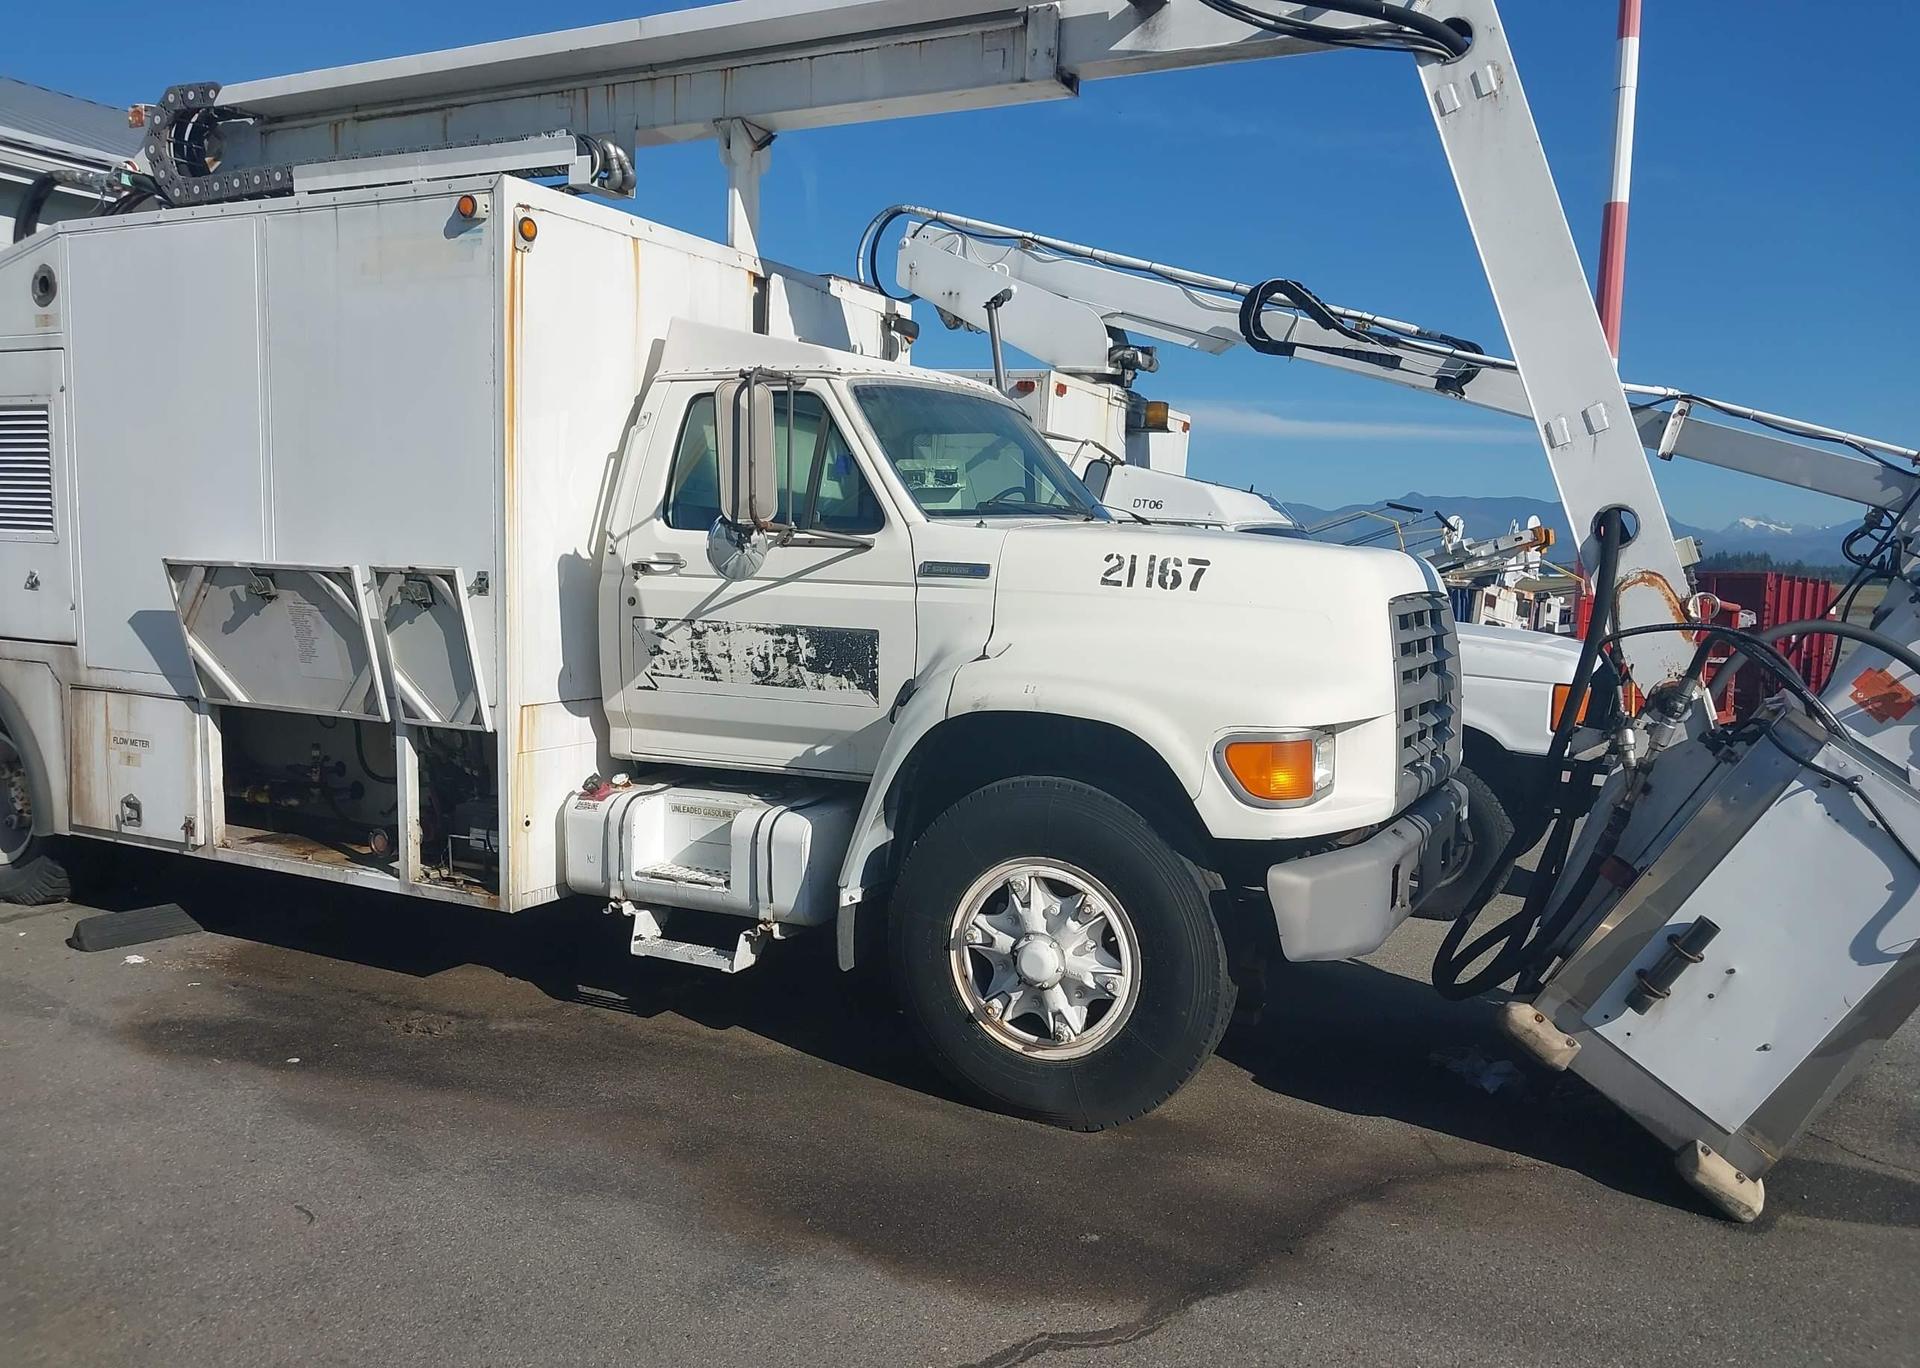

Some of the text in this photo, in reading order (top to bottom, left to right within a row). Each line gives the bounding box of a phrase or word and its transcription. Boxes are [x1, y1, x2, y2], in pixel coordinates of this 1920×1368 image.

[1132, 498, 1164, 510] DT06
[1100, 553, 1211, 592] 21167
[112, 736, 150, 748] FLOW METER
[670, 804, 702, 815] UNLEADED
[703, 807, 732, 818] GASOLINE
